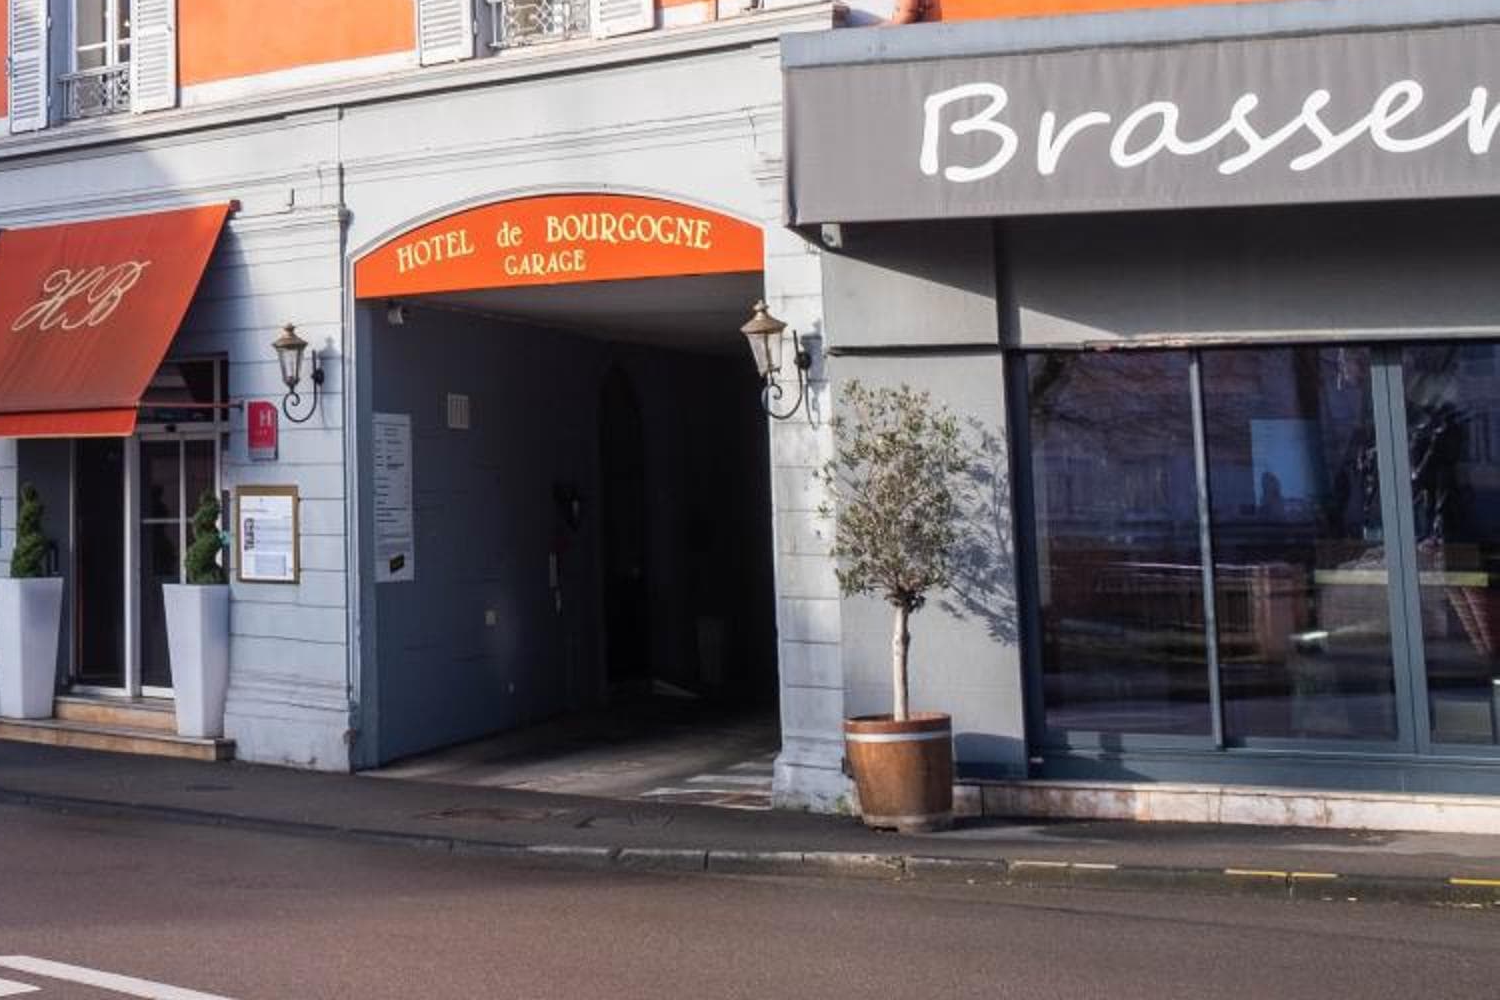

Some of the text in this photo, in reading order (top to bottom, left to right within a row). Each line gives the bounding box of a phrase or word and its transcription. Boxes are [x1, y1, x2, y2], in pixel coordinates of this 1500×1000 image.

[397, 213, 712, 273] HOTEL de BOURGOGNE
[503, 250, 587, 276] GARAGE
